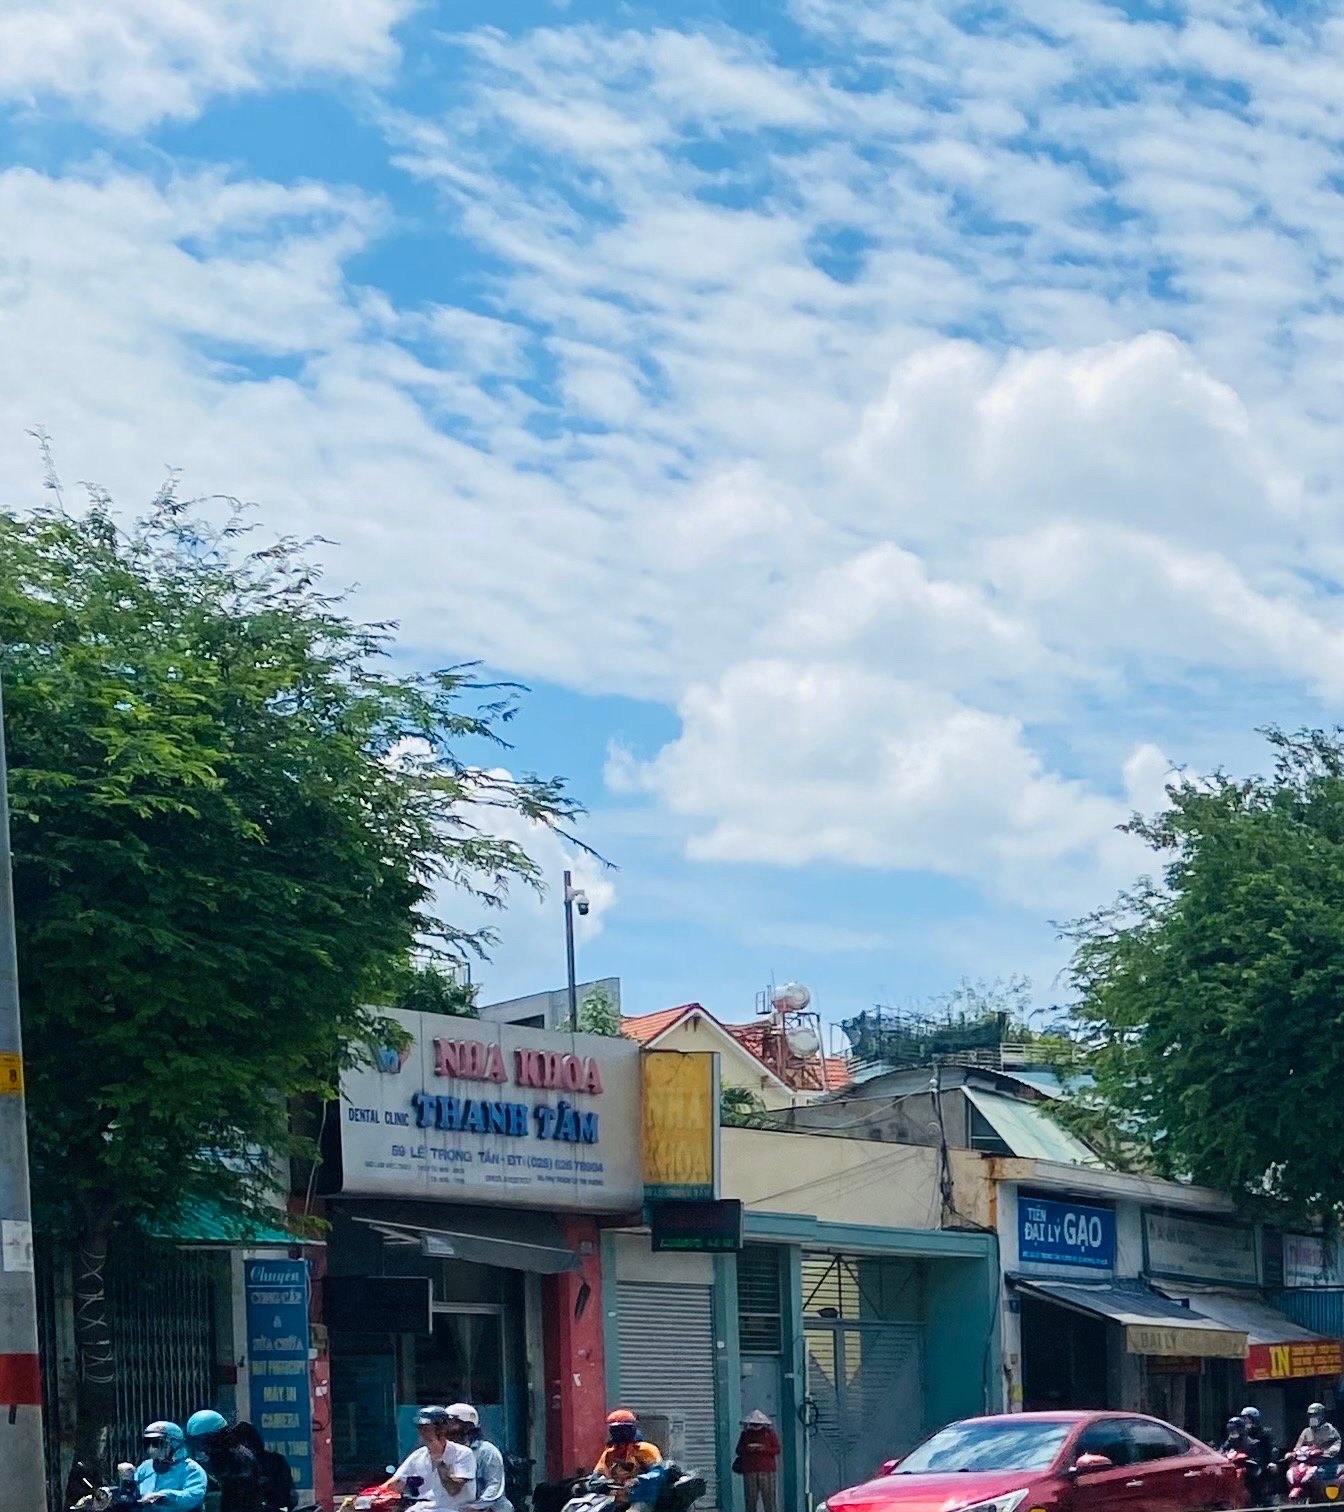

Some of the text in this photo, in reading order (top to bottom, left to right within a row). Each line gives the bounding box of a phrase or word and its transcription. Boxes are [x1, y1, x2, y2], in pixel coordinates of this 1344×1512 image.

[433, 1037, 604, 1095] NHA KHOA
[348, 1107, 410, 1127] DENTAL CLINIC
[412, 1092, 529, 1137] THANH
[1063, 1212, 1102, 1252] GẠO
[1268, 1345, 1291, 1378] IN
